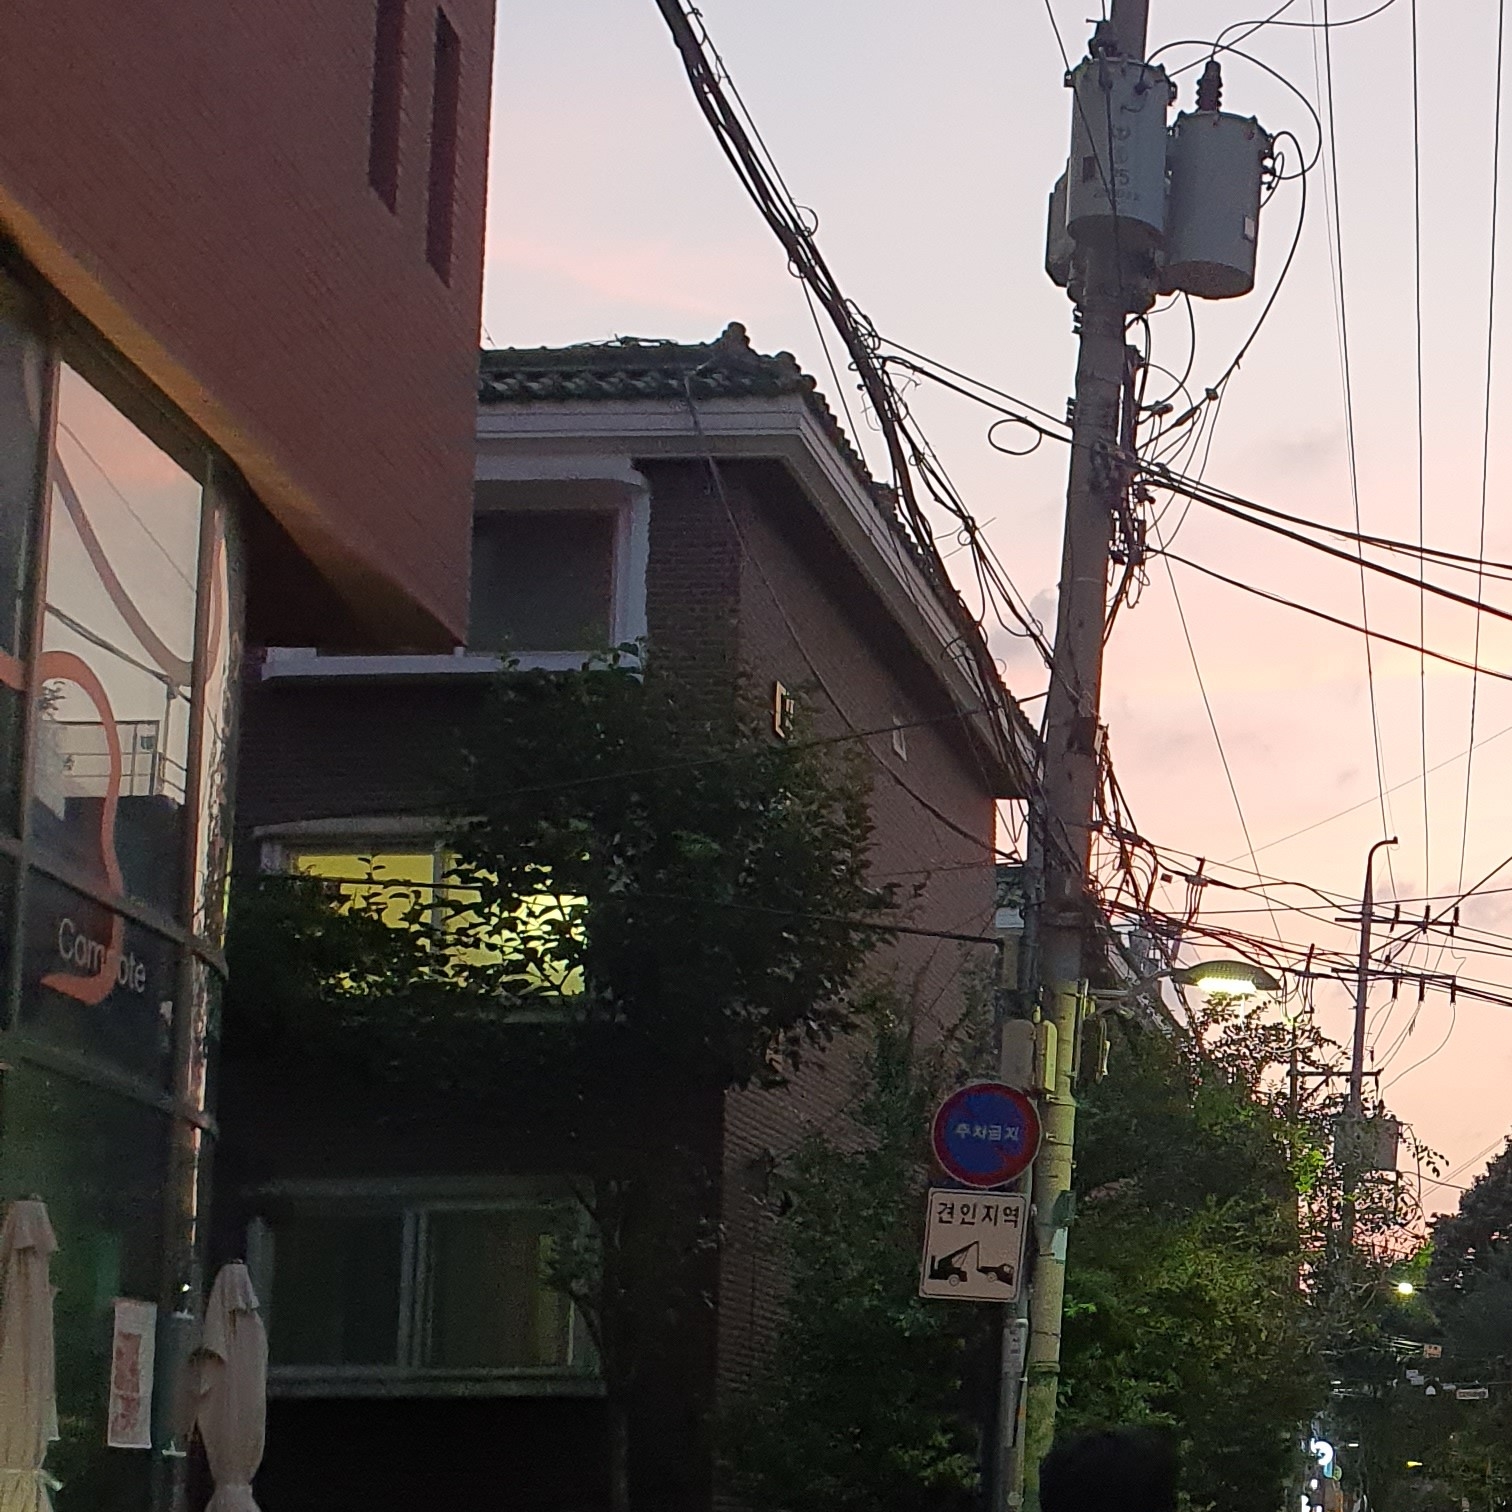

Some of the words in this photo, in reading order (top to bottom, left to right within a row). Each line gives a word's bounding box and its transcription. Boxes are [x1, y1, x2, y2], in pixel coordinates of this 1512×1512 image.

[59, 918, 146, 993] Comote
[954, 1122, 1020, 1142] 주차금지
[936, 1202, 1020, 1229] 견인지역
